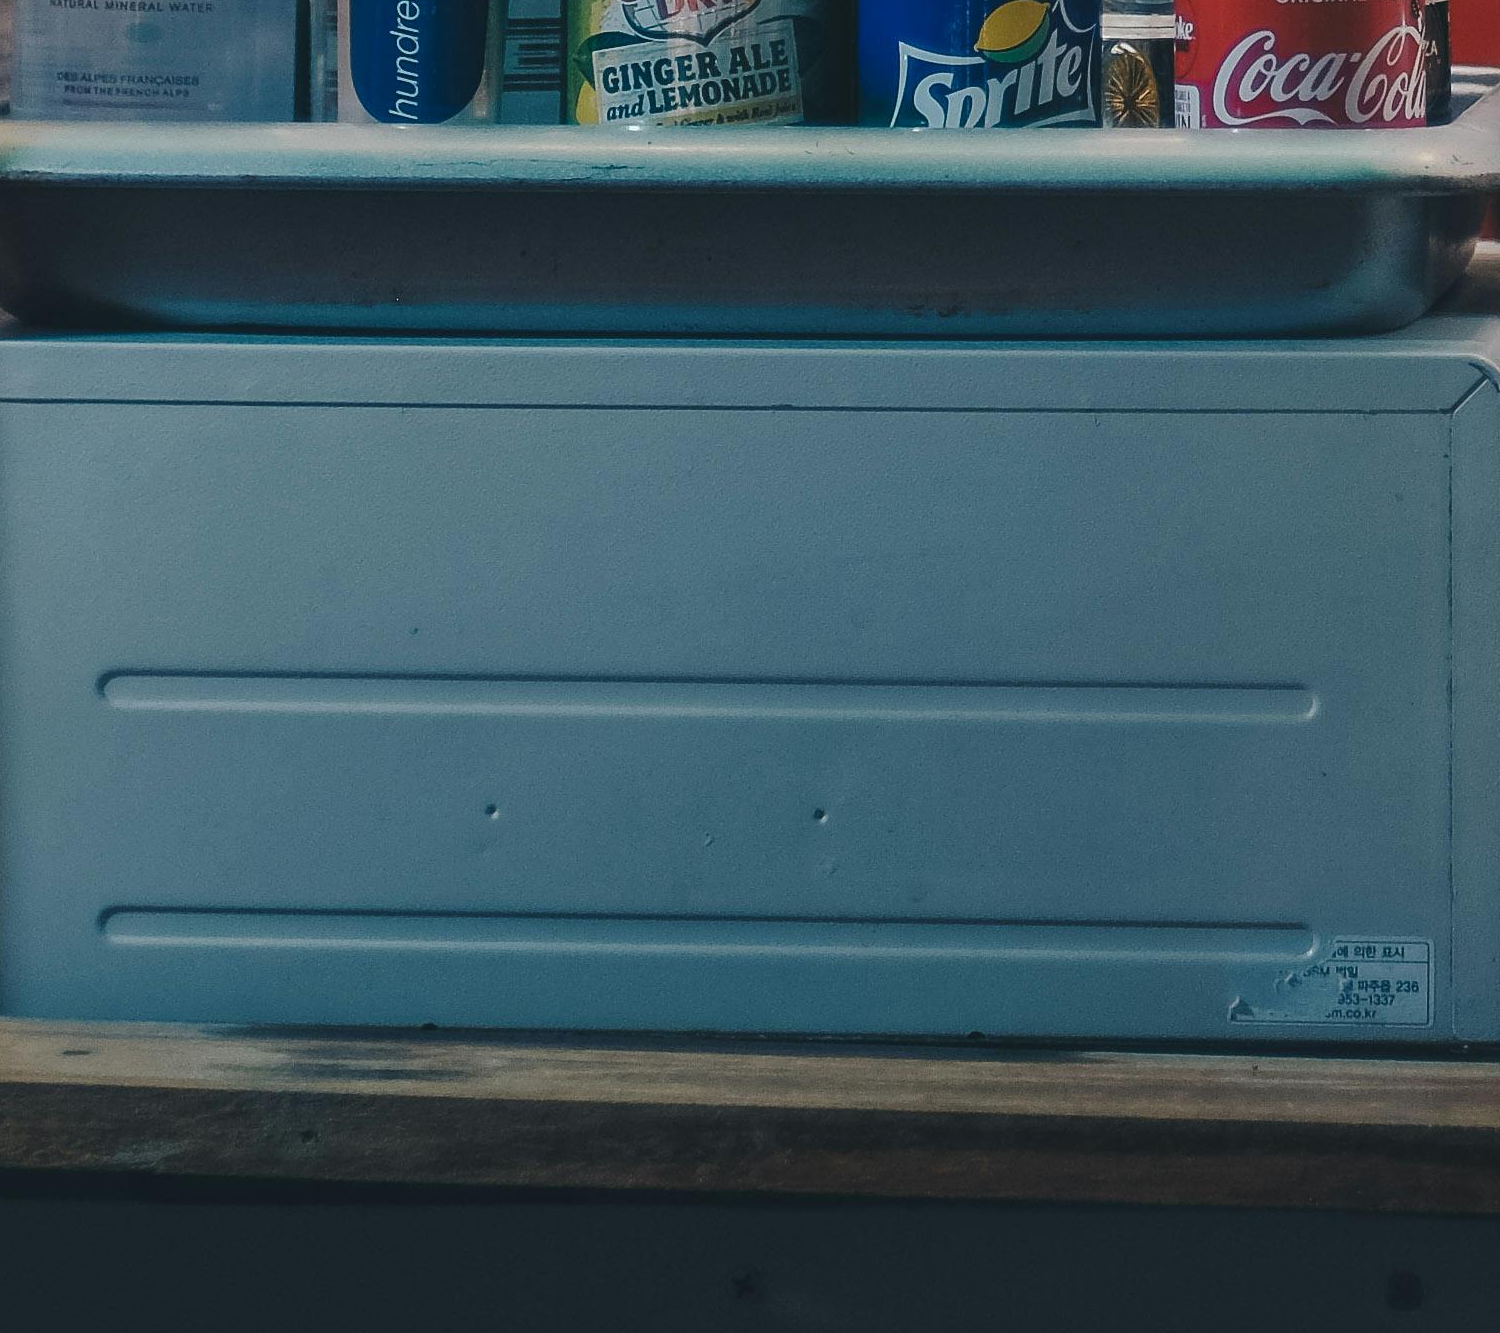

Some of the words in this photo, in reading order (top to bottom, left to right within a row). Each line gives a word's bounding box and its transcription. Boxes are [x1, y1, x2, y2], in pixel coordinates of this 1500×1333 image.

[104, 0, 164, 13] MINERAL
[169, 2, 214, 14] WATER
[601, 49, 722, 95] GINGER
[729, 37, 789, 75] ALE
[913, 27, 1083, 128] Sprite
[605, 90, 646, 122] and
[648, 67, 792, 116] LEMONADE
